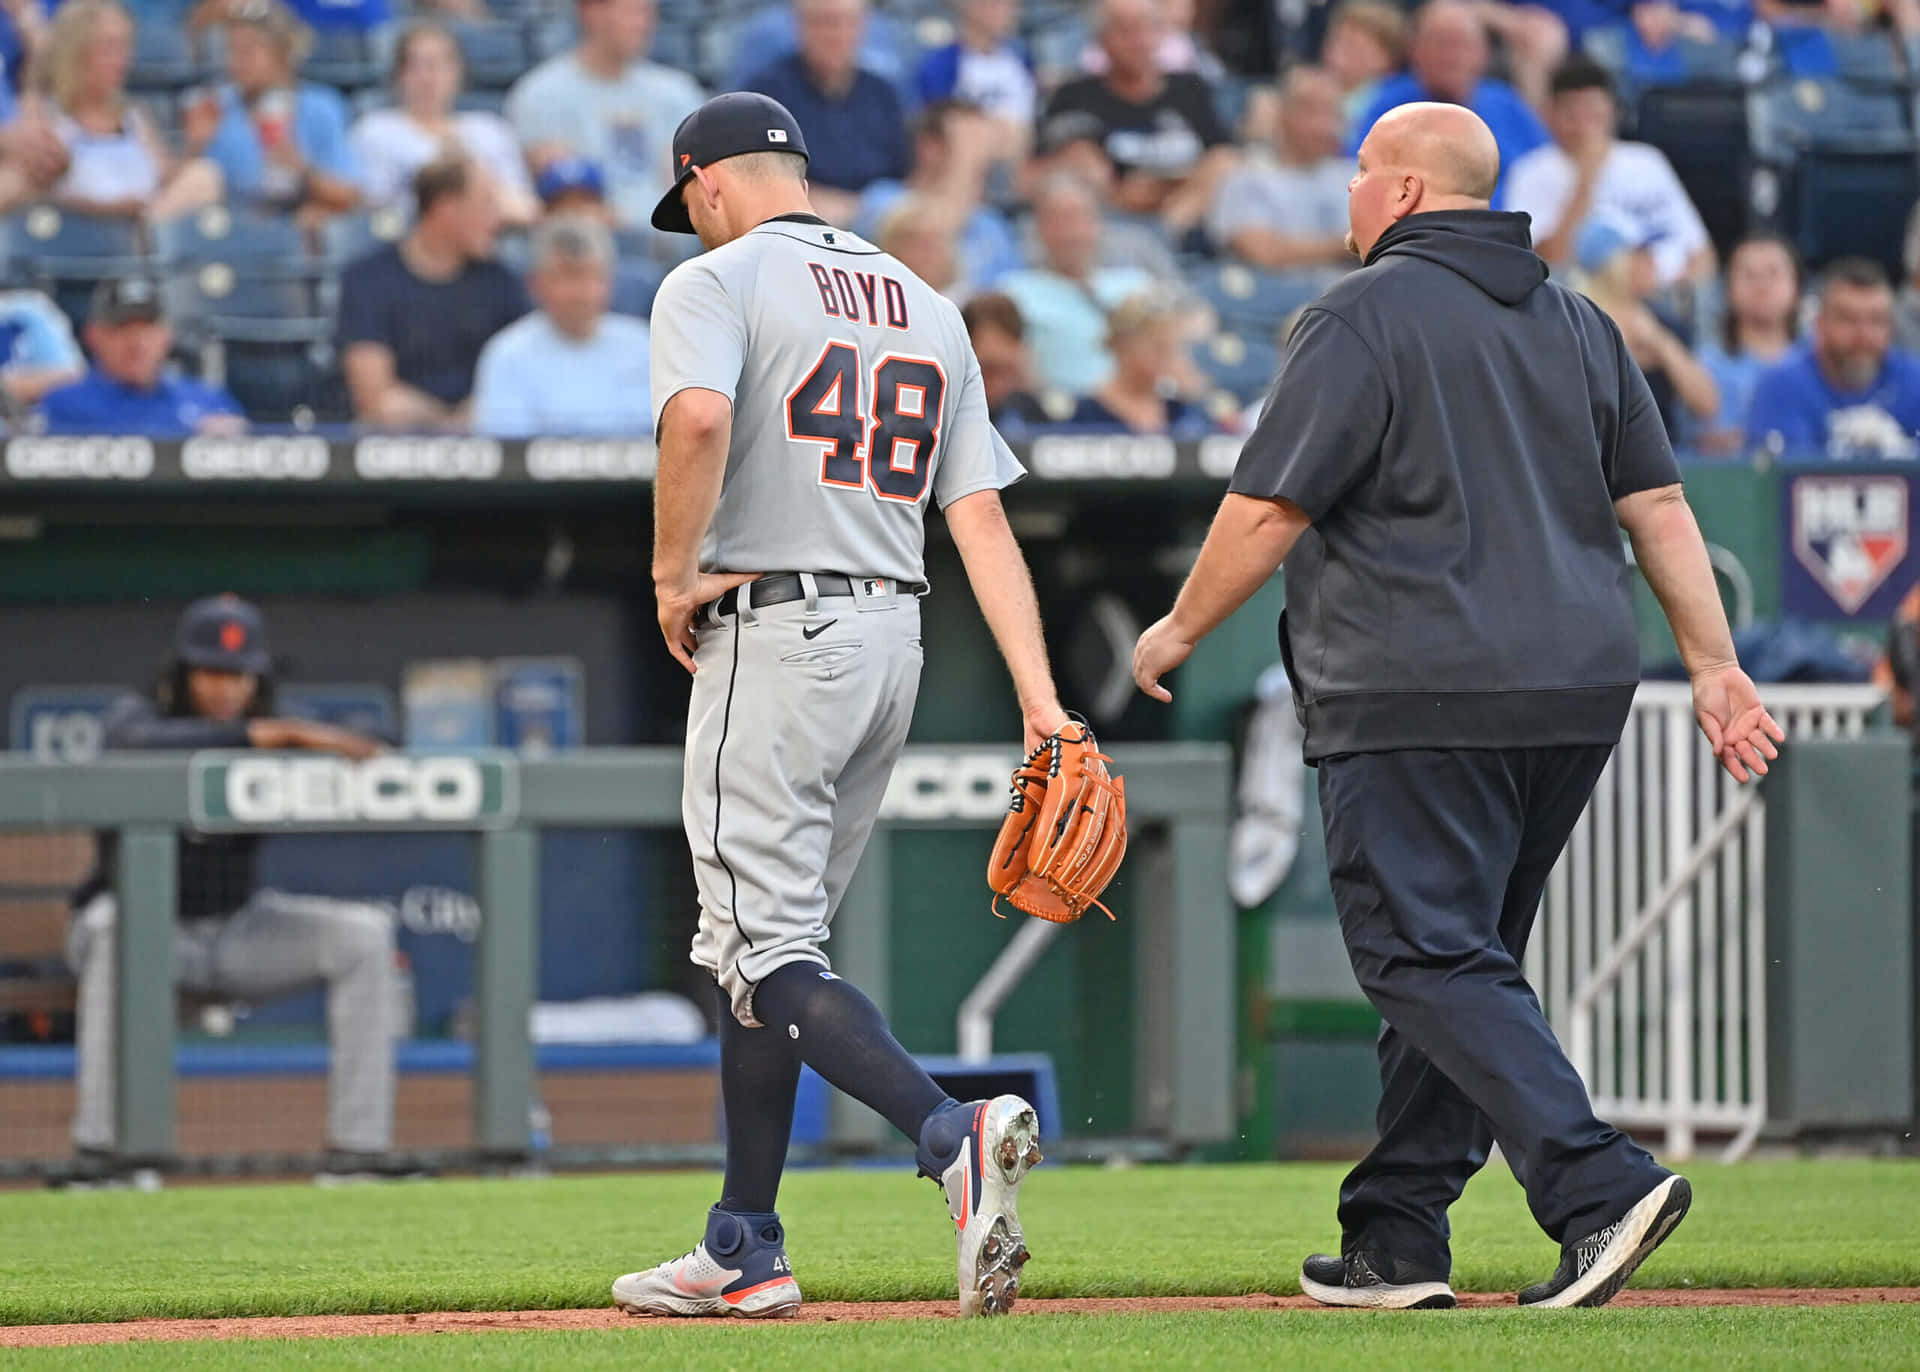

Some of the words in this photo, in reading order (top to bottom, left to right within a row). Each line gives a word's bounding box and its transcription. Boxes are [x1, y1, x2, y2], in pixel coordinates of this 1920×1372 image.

[806, 260, 912, 333] BOYD
[784, 337, 948, 506] 48
[6, 435, 154, 479] GEICO
[181, 435, 330, 479] GEICO
[354, 435, 502, 479] GEICO
[225, 756, 483, 822] GEICO
[773, 1255, 792, 1272] 48
